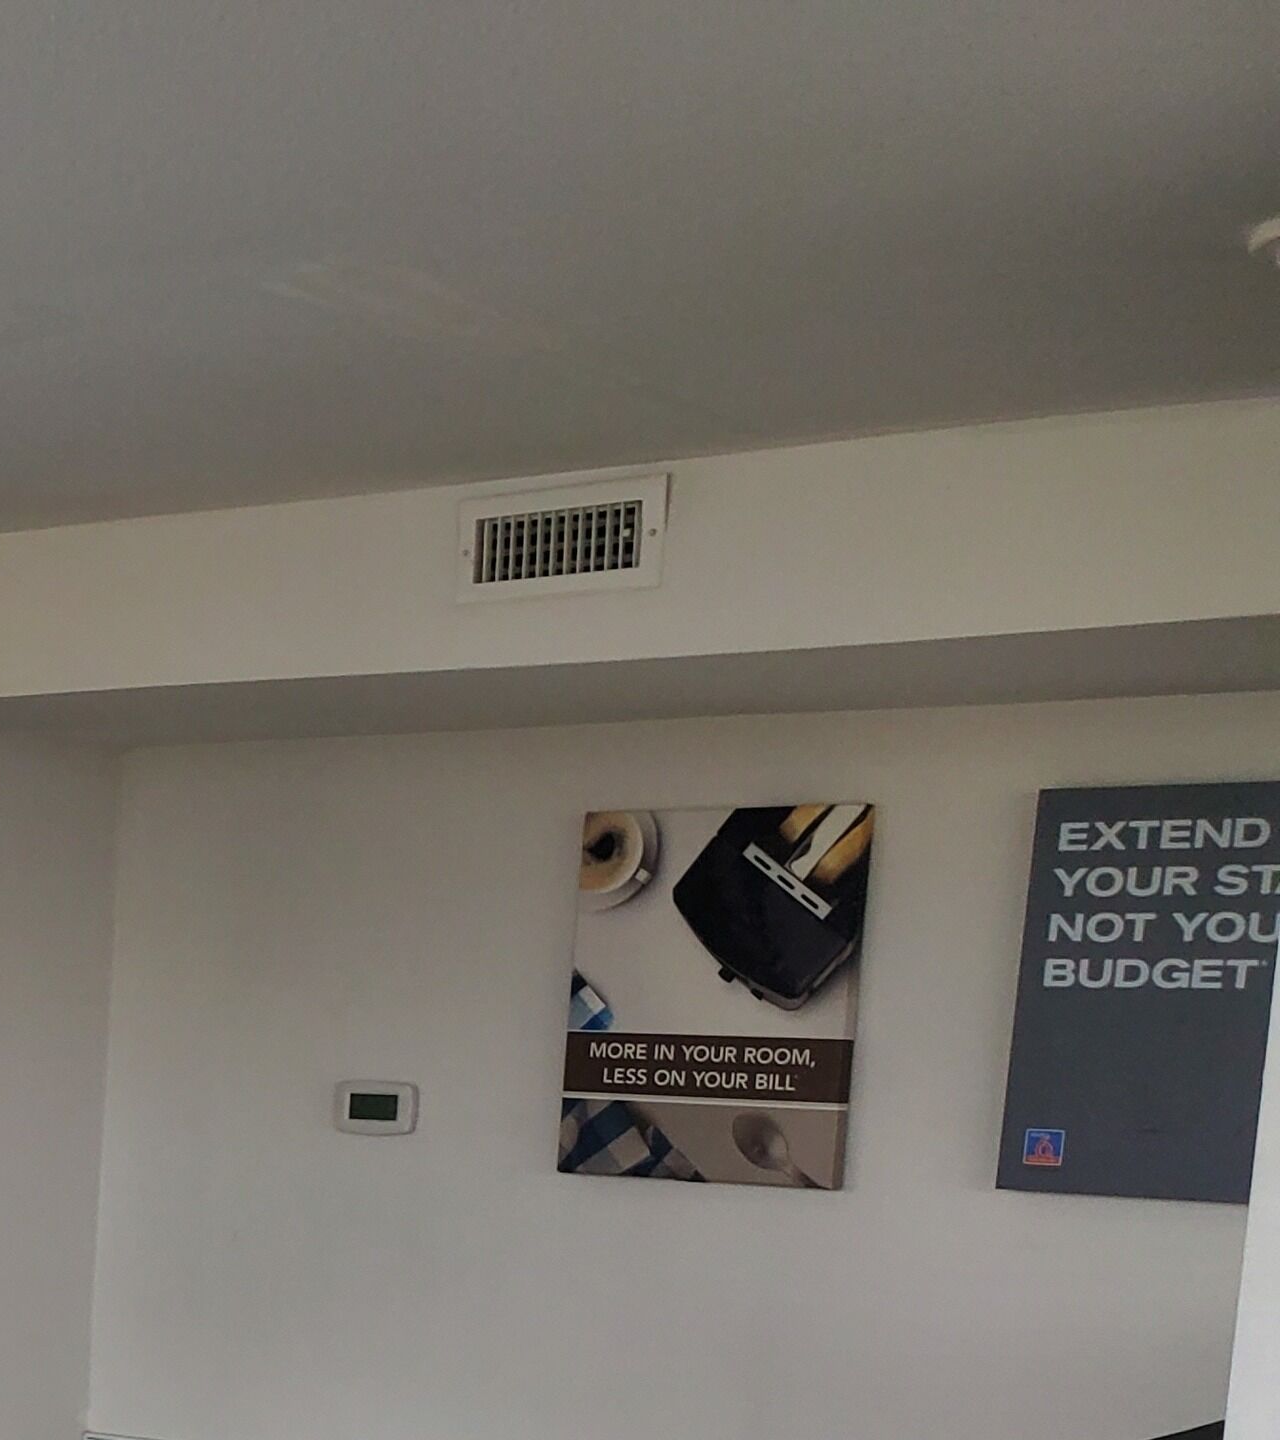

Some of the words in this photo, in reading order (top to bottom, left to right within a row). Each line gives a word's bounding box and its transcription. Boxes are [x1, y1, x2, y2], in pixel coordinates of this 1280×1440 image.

[1057, 817, 1272, 853] EXTEND
[1054, 865, 1199, 898] YOUR
[1214, 864, 1280, 896] ST
[1047, 911, 1158, 944] NOT
[1042, 958, 1260, 990] BUDGET
[589, 1041, 648, 1061] MORE
[653, 1044, 675, 1061] IN
[681, 1045, 737, 1064] YOUR
[743, 1047, 816, 1068] ROOM,
[602, 1067, 648, 1086] LESS
[654, 1069, 686, 1088] ON
[692, 1071, 749, 1090] YOUR
[755, 1073, 796, 1091] BILL
